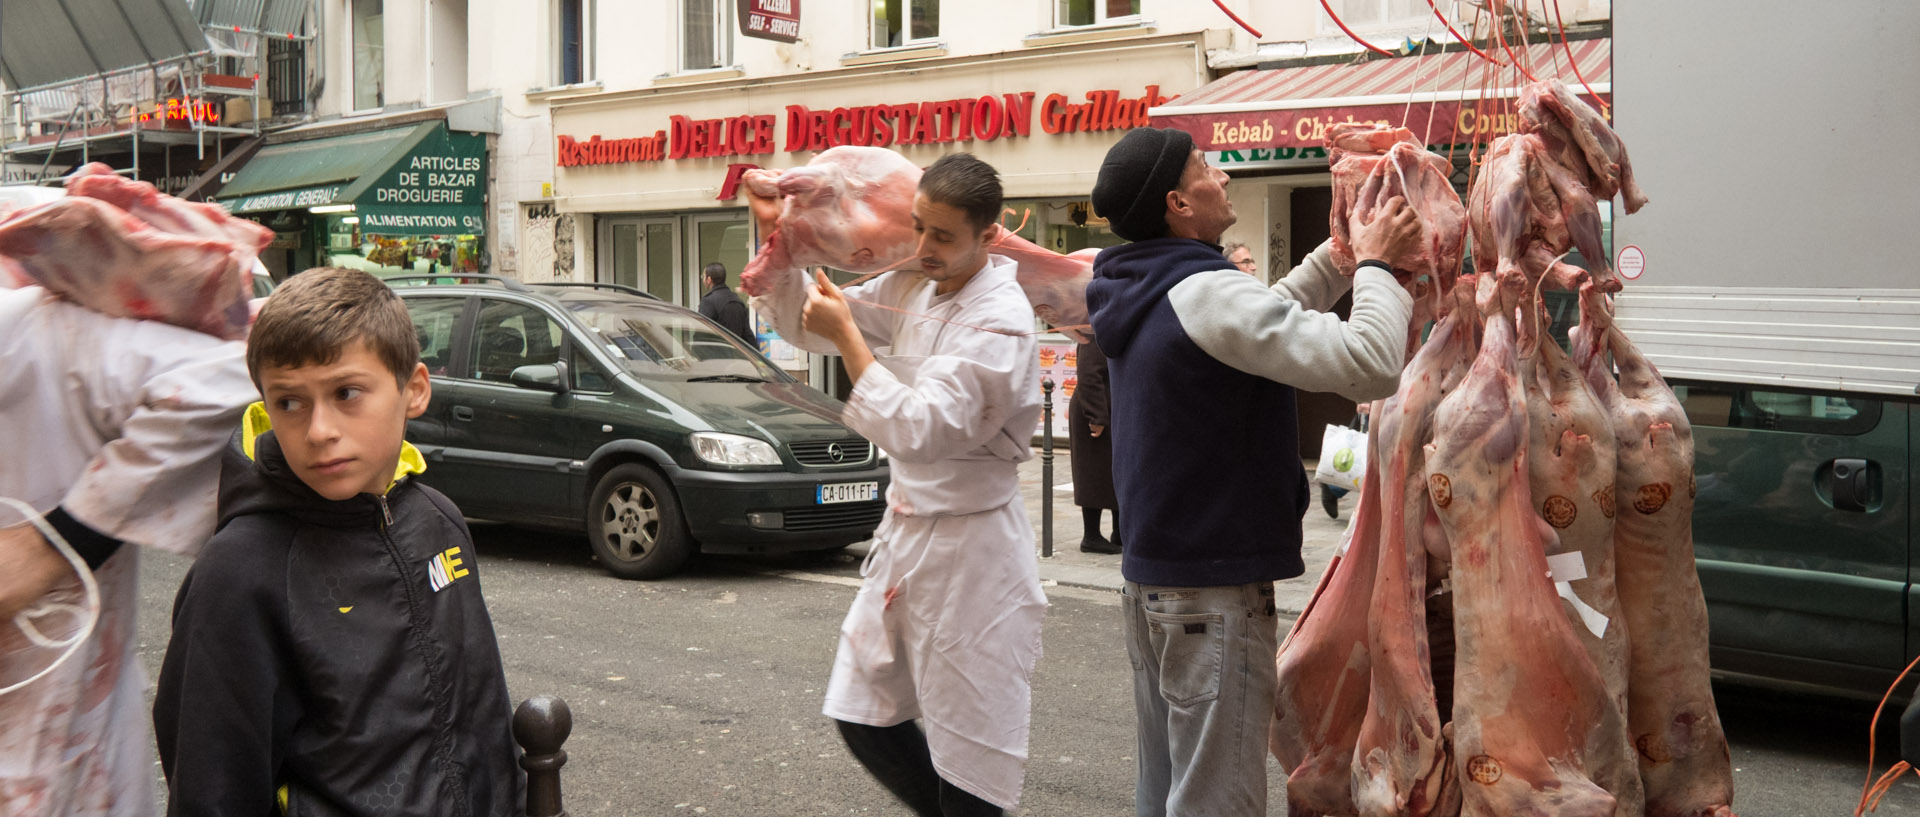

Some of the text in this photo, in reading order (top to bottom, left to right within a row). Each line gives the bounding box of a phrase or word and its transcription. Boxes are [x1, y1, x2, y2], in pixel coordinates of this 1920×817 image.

[750, 14, 766, 31] SELF
[770, 18, 798, 37] SERVICE
[557, 130, 667, 167] Restaurant
[668, 114, 776, 160] DELICE
[784, 91, 1036, 153] DEGUSTATION
[1211, 118, 1274, 145] Kebab
[1458, 108, 1518, 136] Cous
[410, 156, 481, 171] ARTICLES
[399, 172, 476, 188] DE BAZAR
[240, 192, 296, 212] ALIMENTATION
[377, 188, 463, 204] DROGUERIE
[365, 214, 457, 228] ALIMENTATION
[428, 546, 469, 592] NIKE
